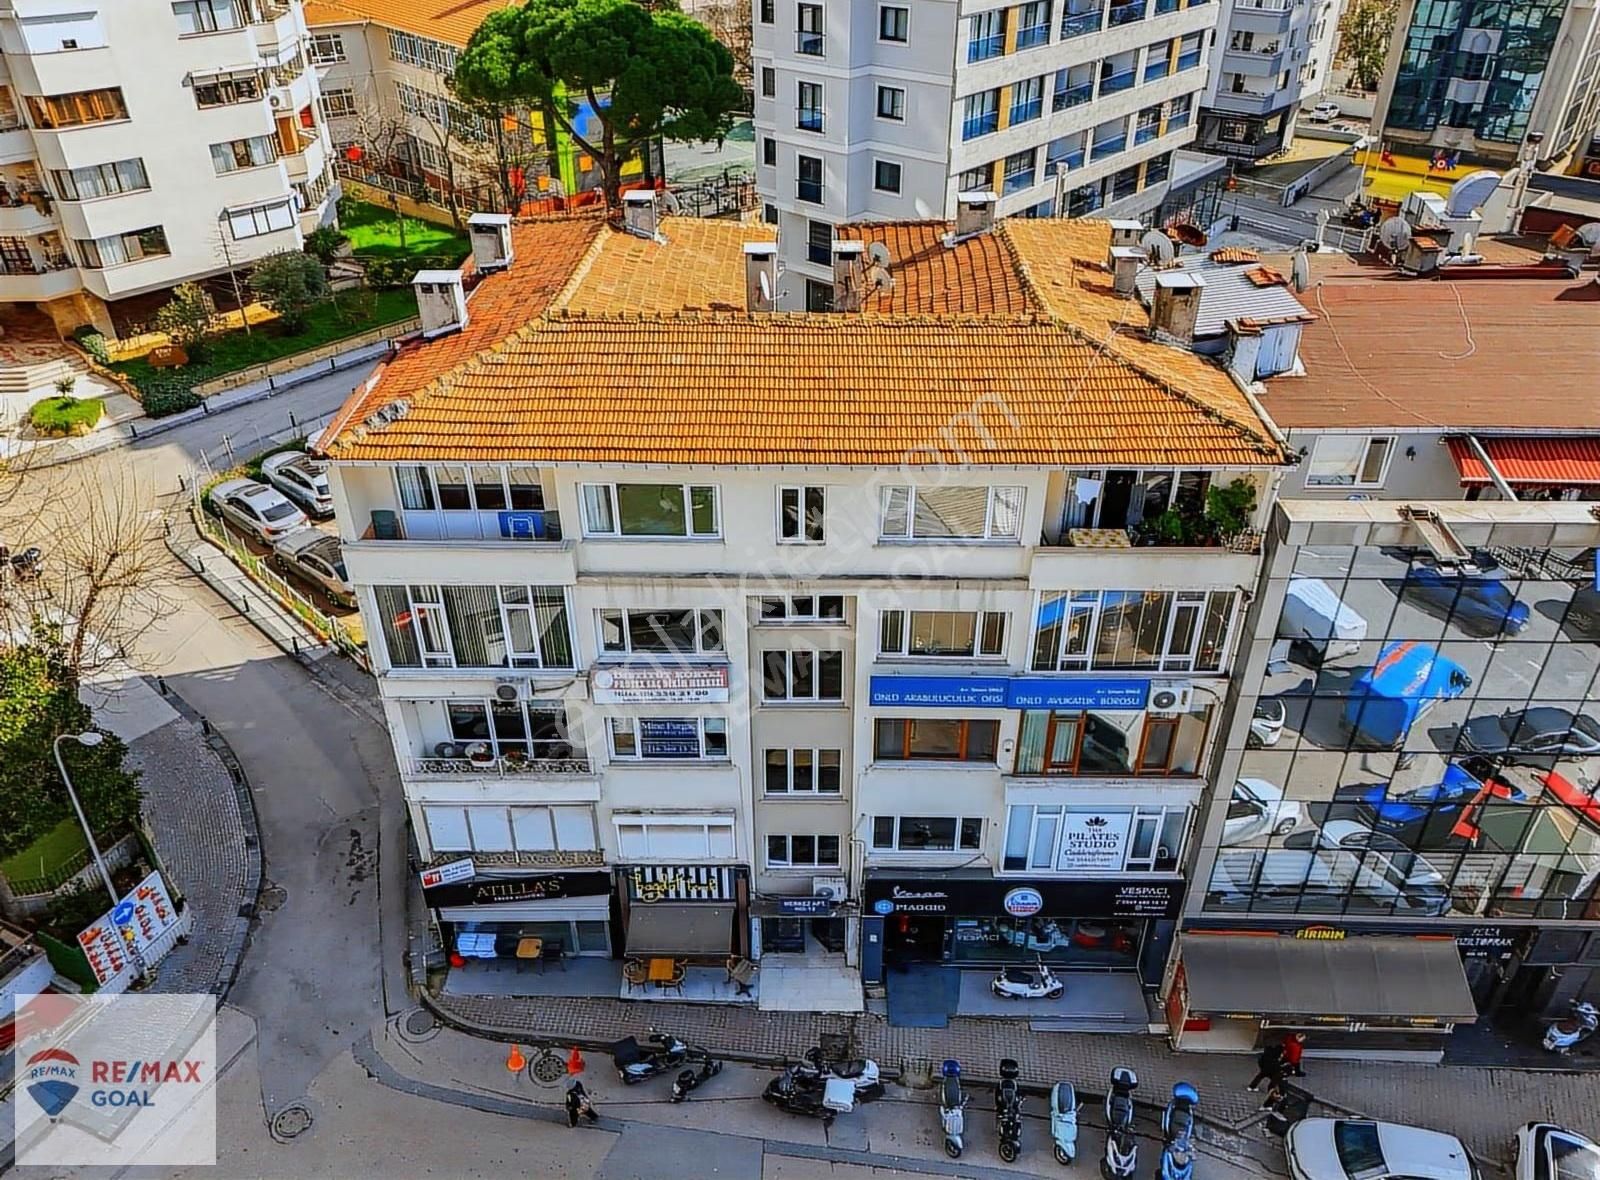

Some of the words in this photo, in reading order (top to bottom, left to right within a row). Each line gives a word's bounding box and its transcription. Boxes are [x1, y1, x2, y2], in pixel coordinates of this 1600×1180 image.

[1068, 832, 1119, 841] PILATES
[1069, 841, 1117, 849] STUDIO
[476, 880, 561, 898] ATILLA'S
